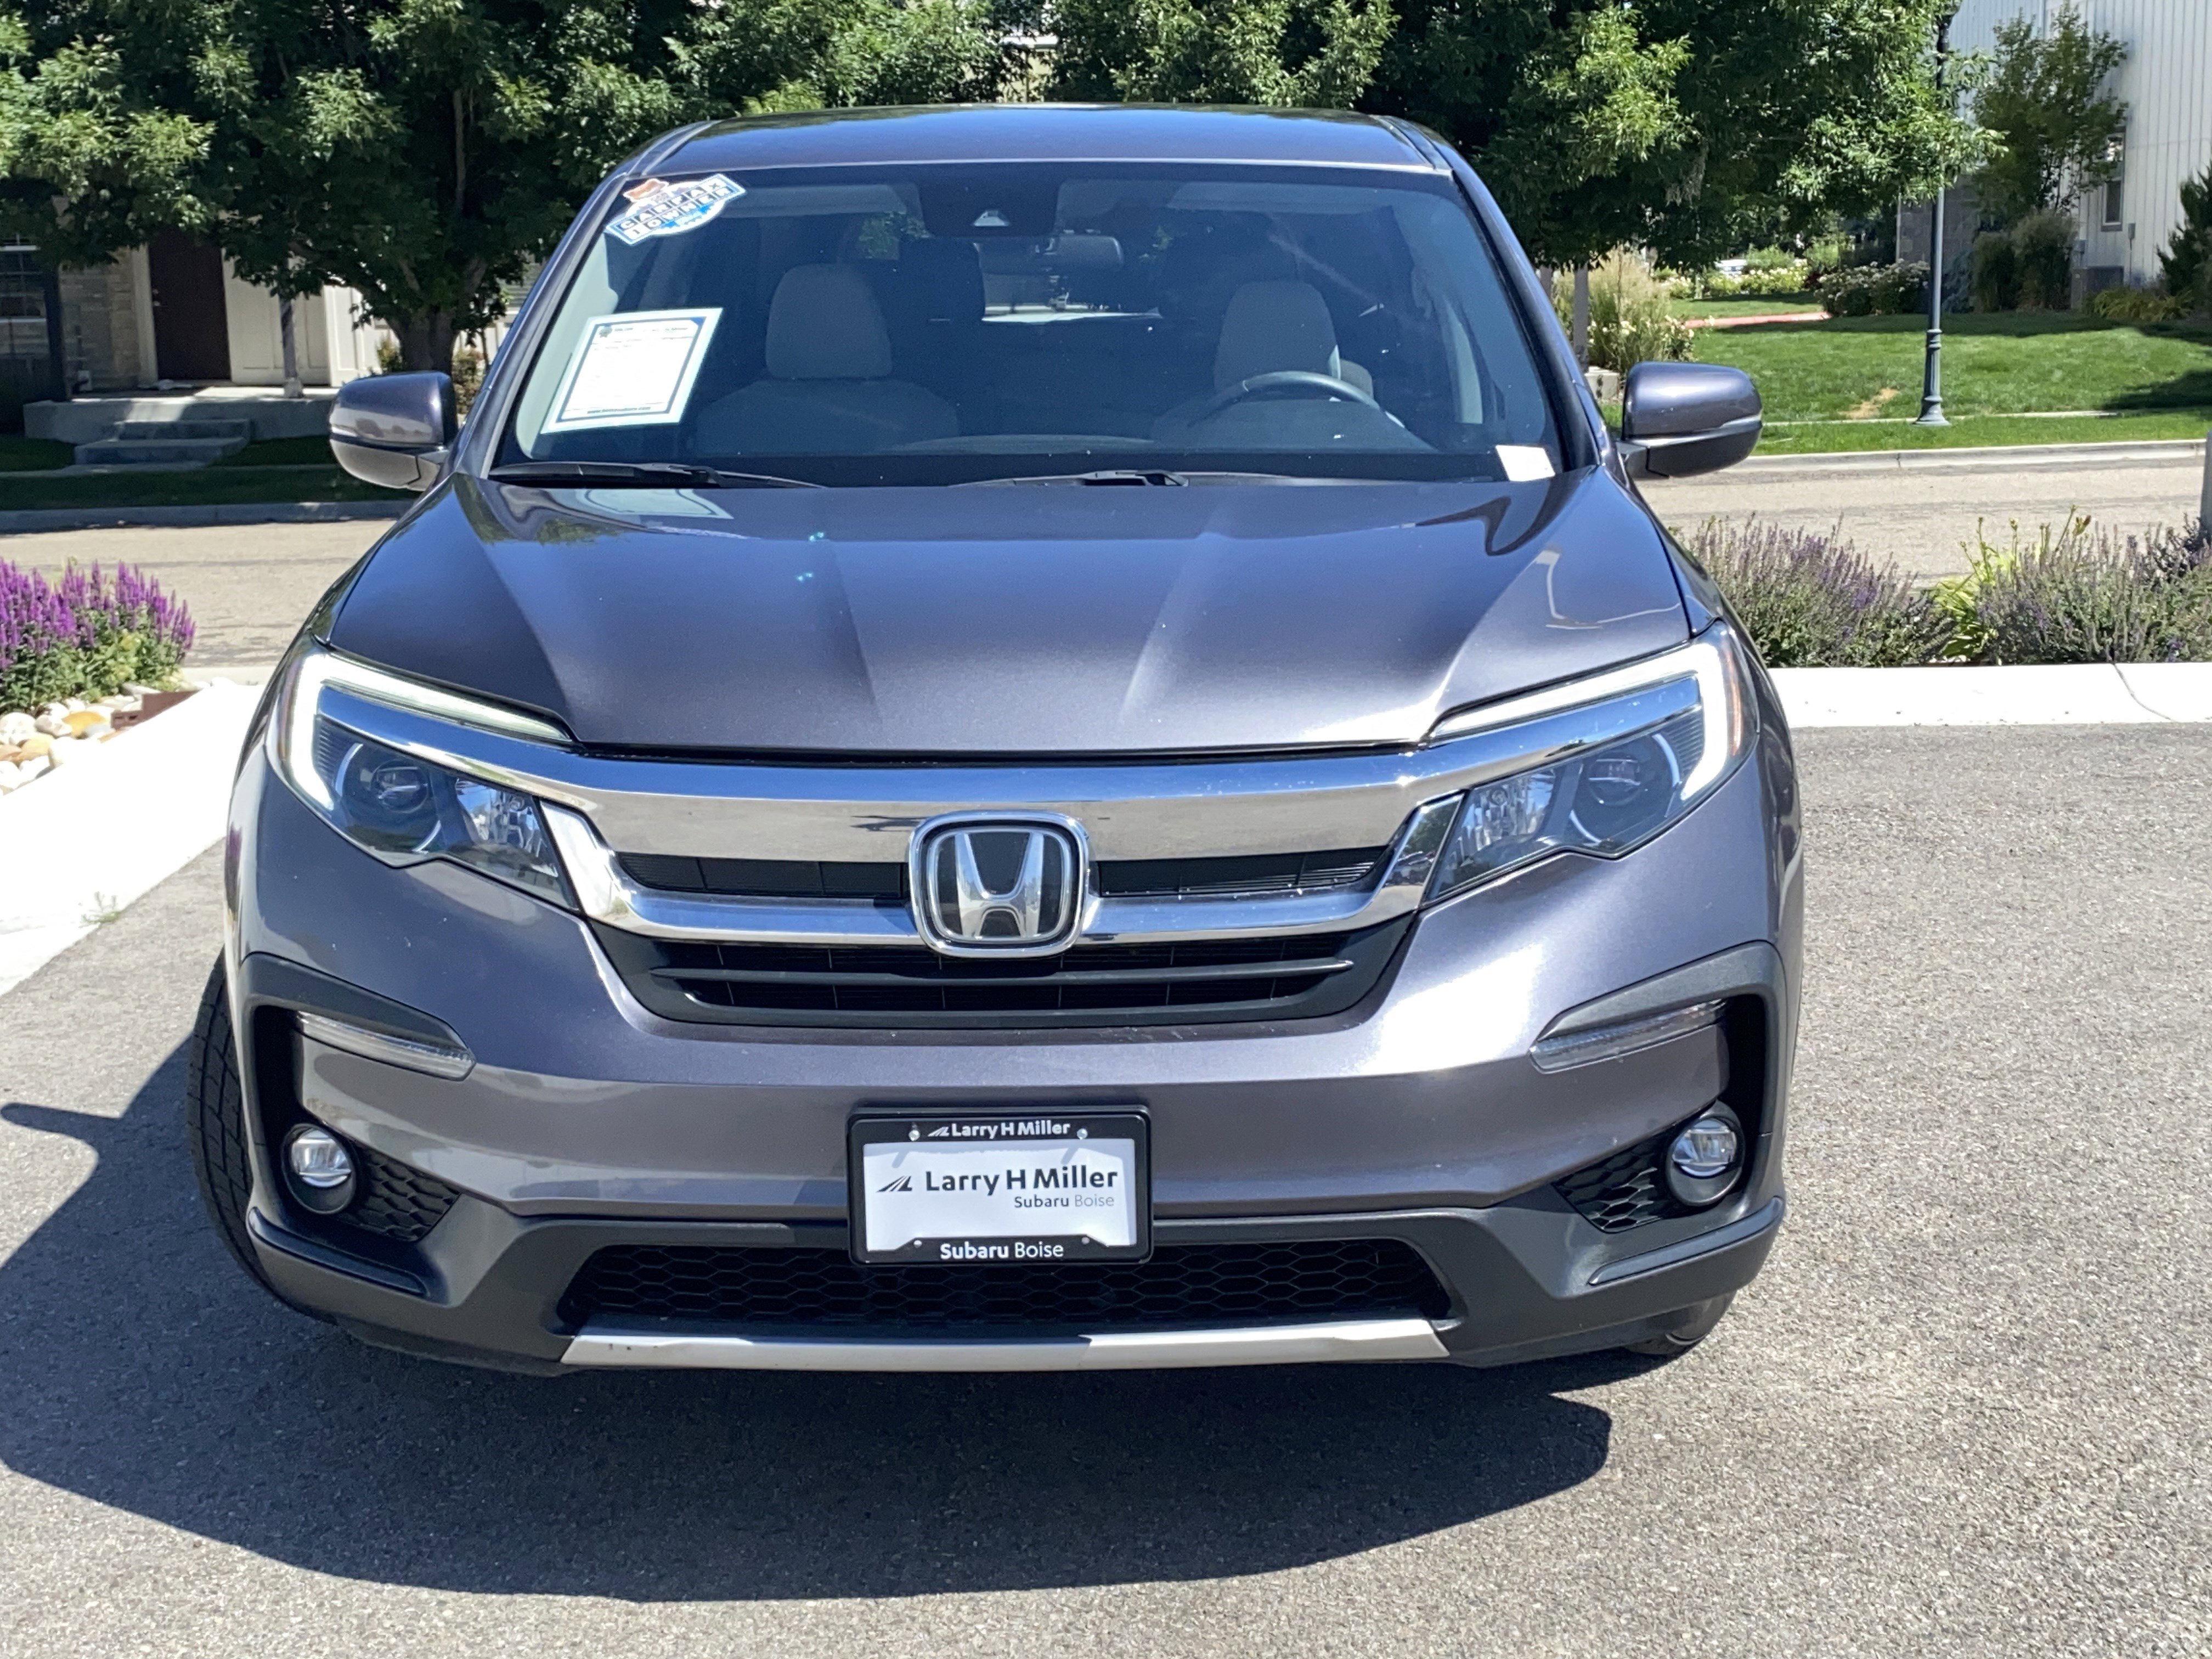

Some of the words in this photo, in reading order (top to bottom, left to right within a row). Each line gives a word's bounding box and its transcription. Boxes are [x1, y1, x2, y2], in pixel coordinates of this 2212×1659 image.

[619, 182, 721, 230] CARFAX
[647, 187, 731, 228] OWNER
[952, 1122, 998, 1139] Larry
[1001, 1124, 1014, 1136] H
[1017, 1120, 1070, 1136] Miller
[926, 1171, 999, 1195] Larry
[1007, 1170, 1026, 1189] H
[1034, 1166, 1117, 1188] Miller
[1014, 1195, 1069, 1207] Subaru
[1074, 1195, 1114, 1207] Boise
[940, 1242, 1009, 1260] Subaru
[1015, 1241, 1064, 1258] Boise
